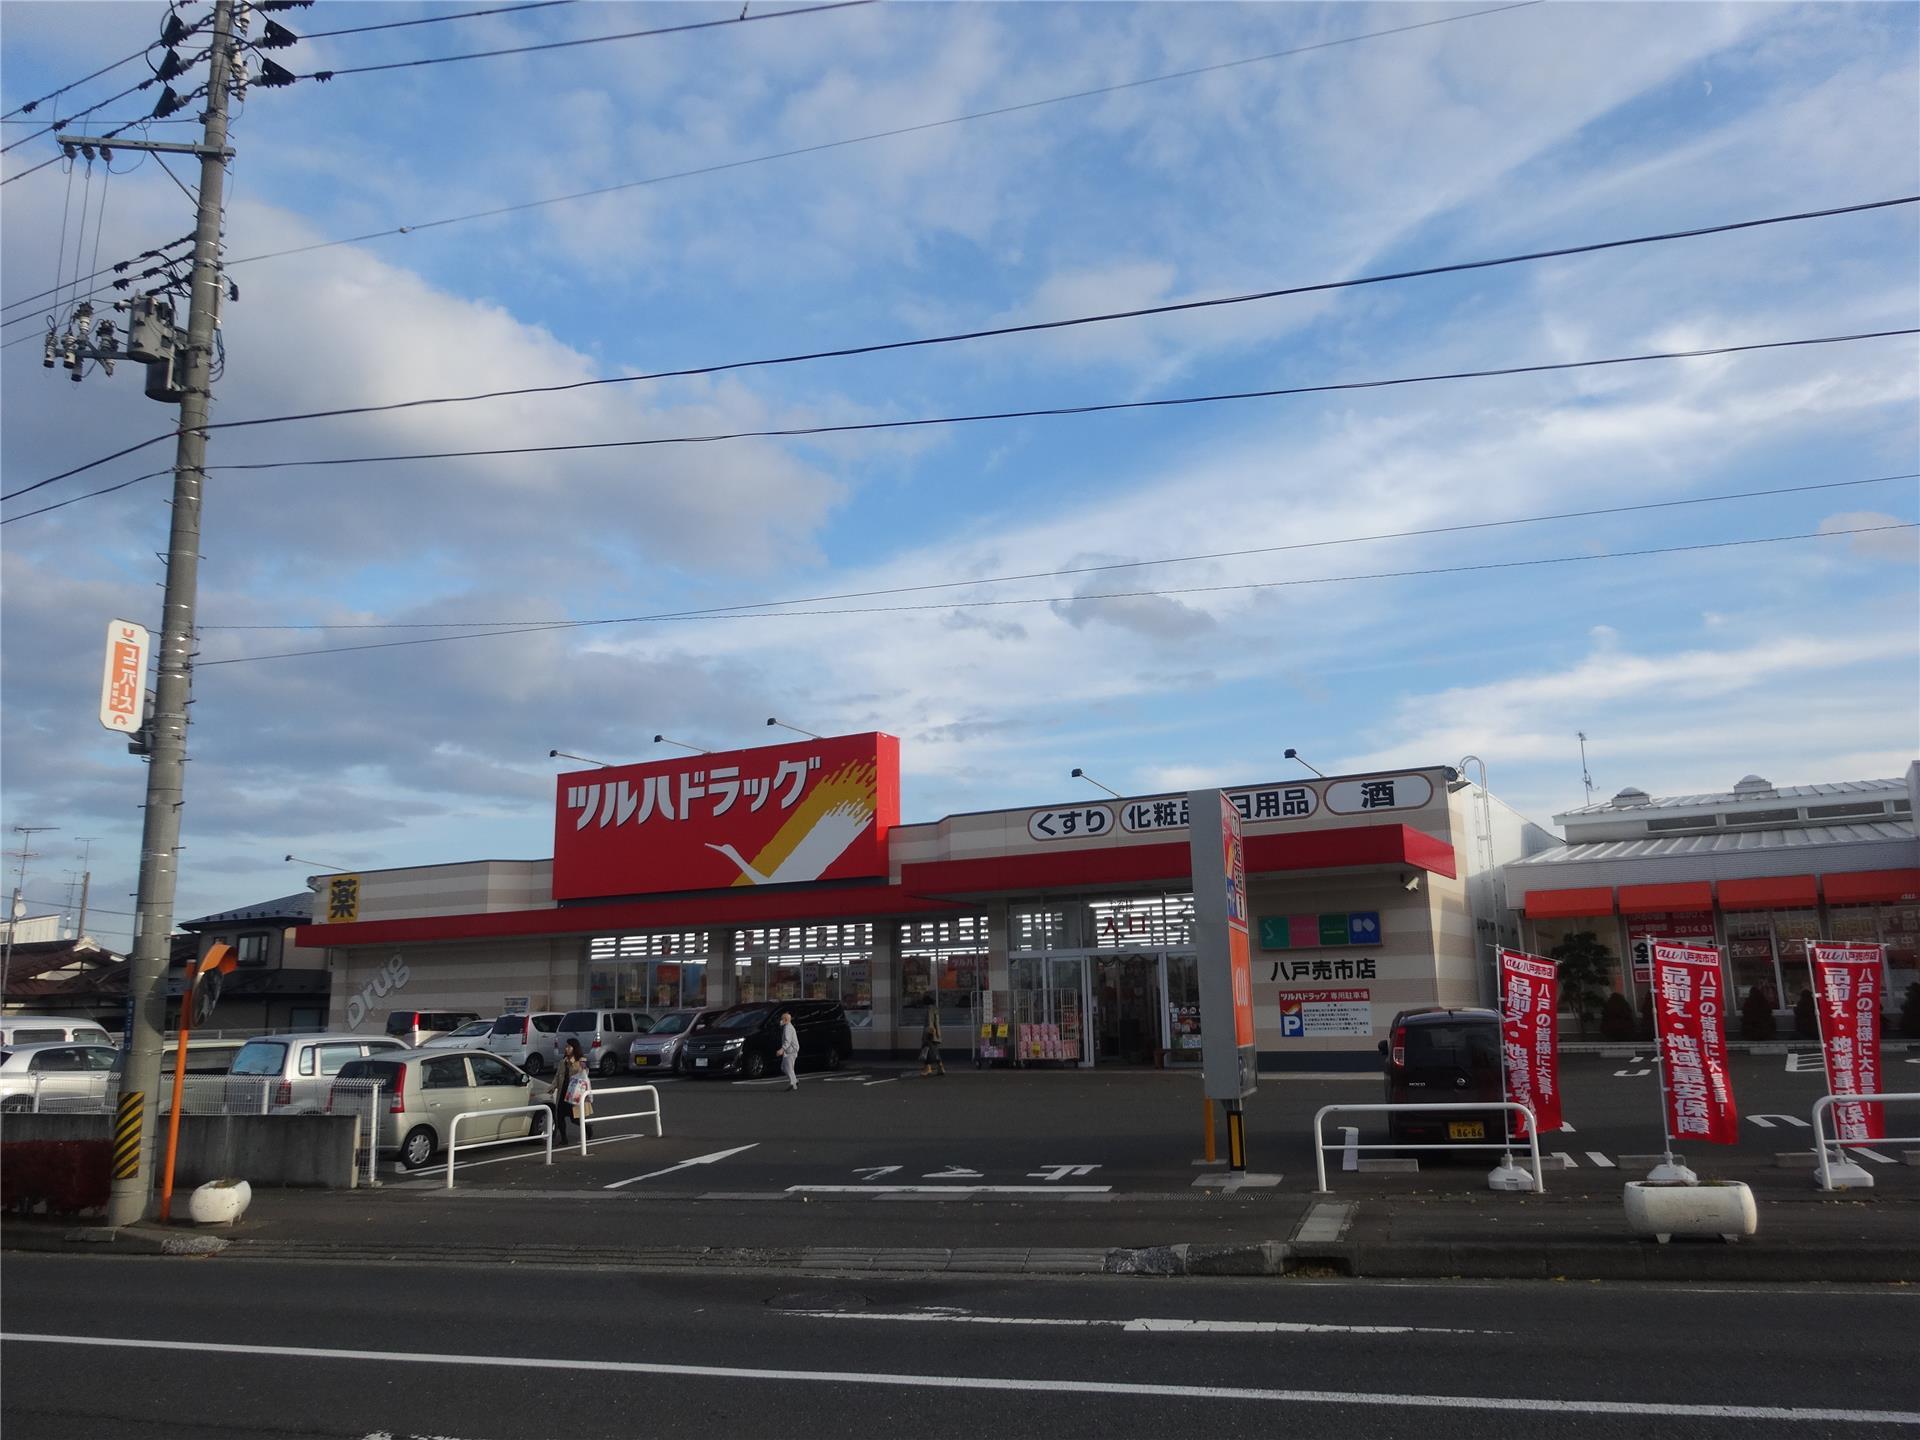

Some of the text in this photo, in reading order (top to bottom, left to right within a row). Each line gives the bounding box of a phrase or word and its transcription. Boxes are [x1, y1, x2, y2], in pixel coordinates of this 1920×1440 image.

[117, 646, 137, 711] ユニバース
[567, 756, 821, 831] ツルハドラッグ
[1360, 780, 1396, 809] 酒
[1034, 810, 1106, 837] くすり
[330, 879, 358, 919] 薬
[1102, 917, 1147, 936] 入口
[1270, 958, 1377, 981] 八戸売市店
[347, 952, 411, 1031] Drug
[1283, 1015, 1301, 1036] P
